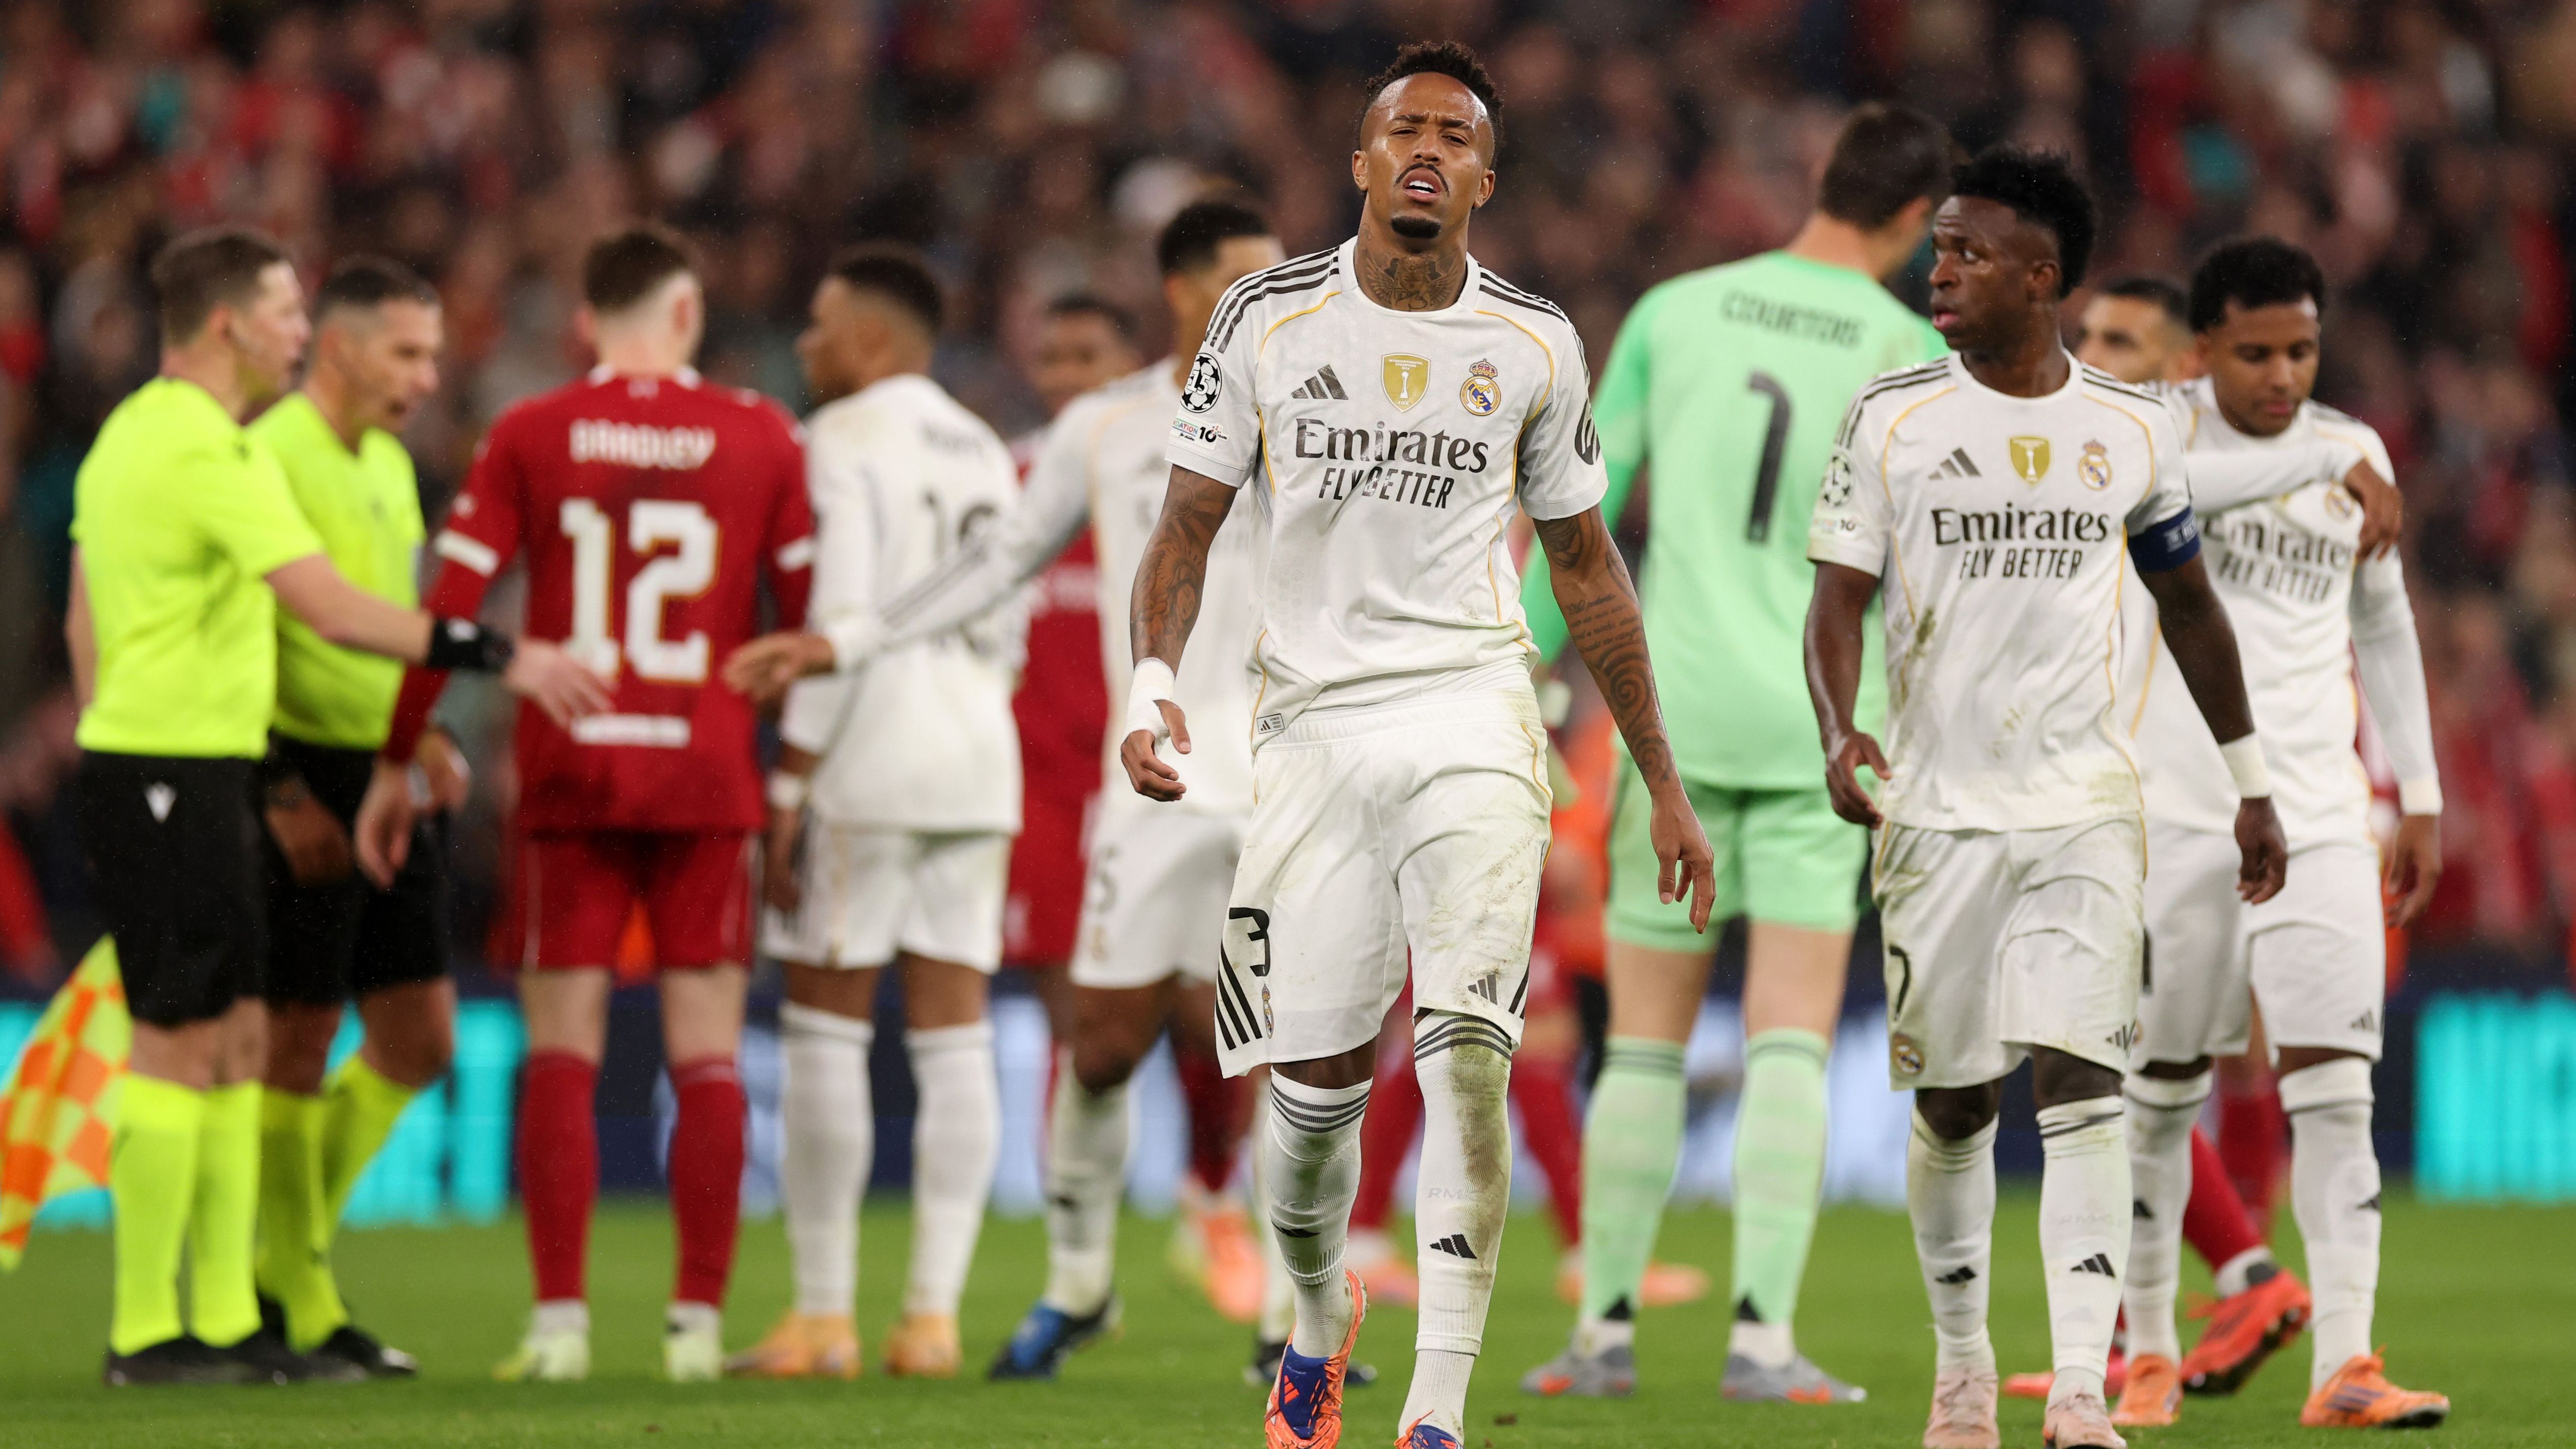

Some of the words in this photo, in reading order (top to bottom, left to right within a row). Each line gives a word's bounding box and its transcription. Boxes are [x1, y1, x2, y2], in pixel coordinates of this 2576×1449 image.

[1187, 369, 1211, 395] 15
[1199, 426, 1217, 443] 10
[1295, 418, 1489, 473] Emirates
[1746, 370, 1793, 545] 1
[1318, 467, 1365, 501] FLY
[1361, 466, 1454, 509] BETTER
[1930, 501, 2110, 546] Emirates
[1959, 547, 1995, 580] FLY
[2002, 547, 2083, 580] BETTER
[559, 496, 722, 686] 12
[1889, 943, 1912, 1021] 7
